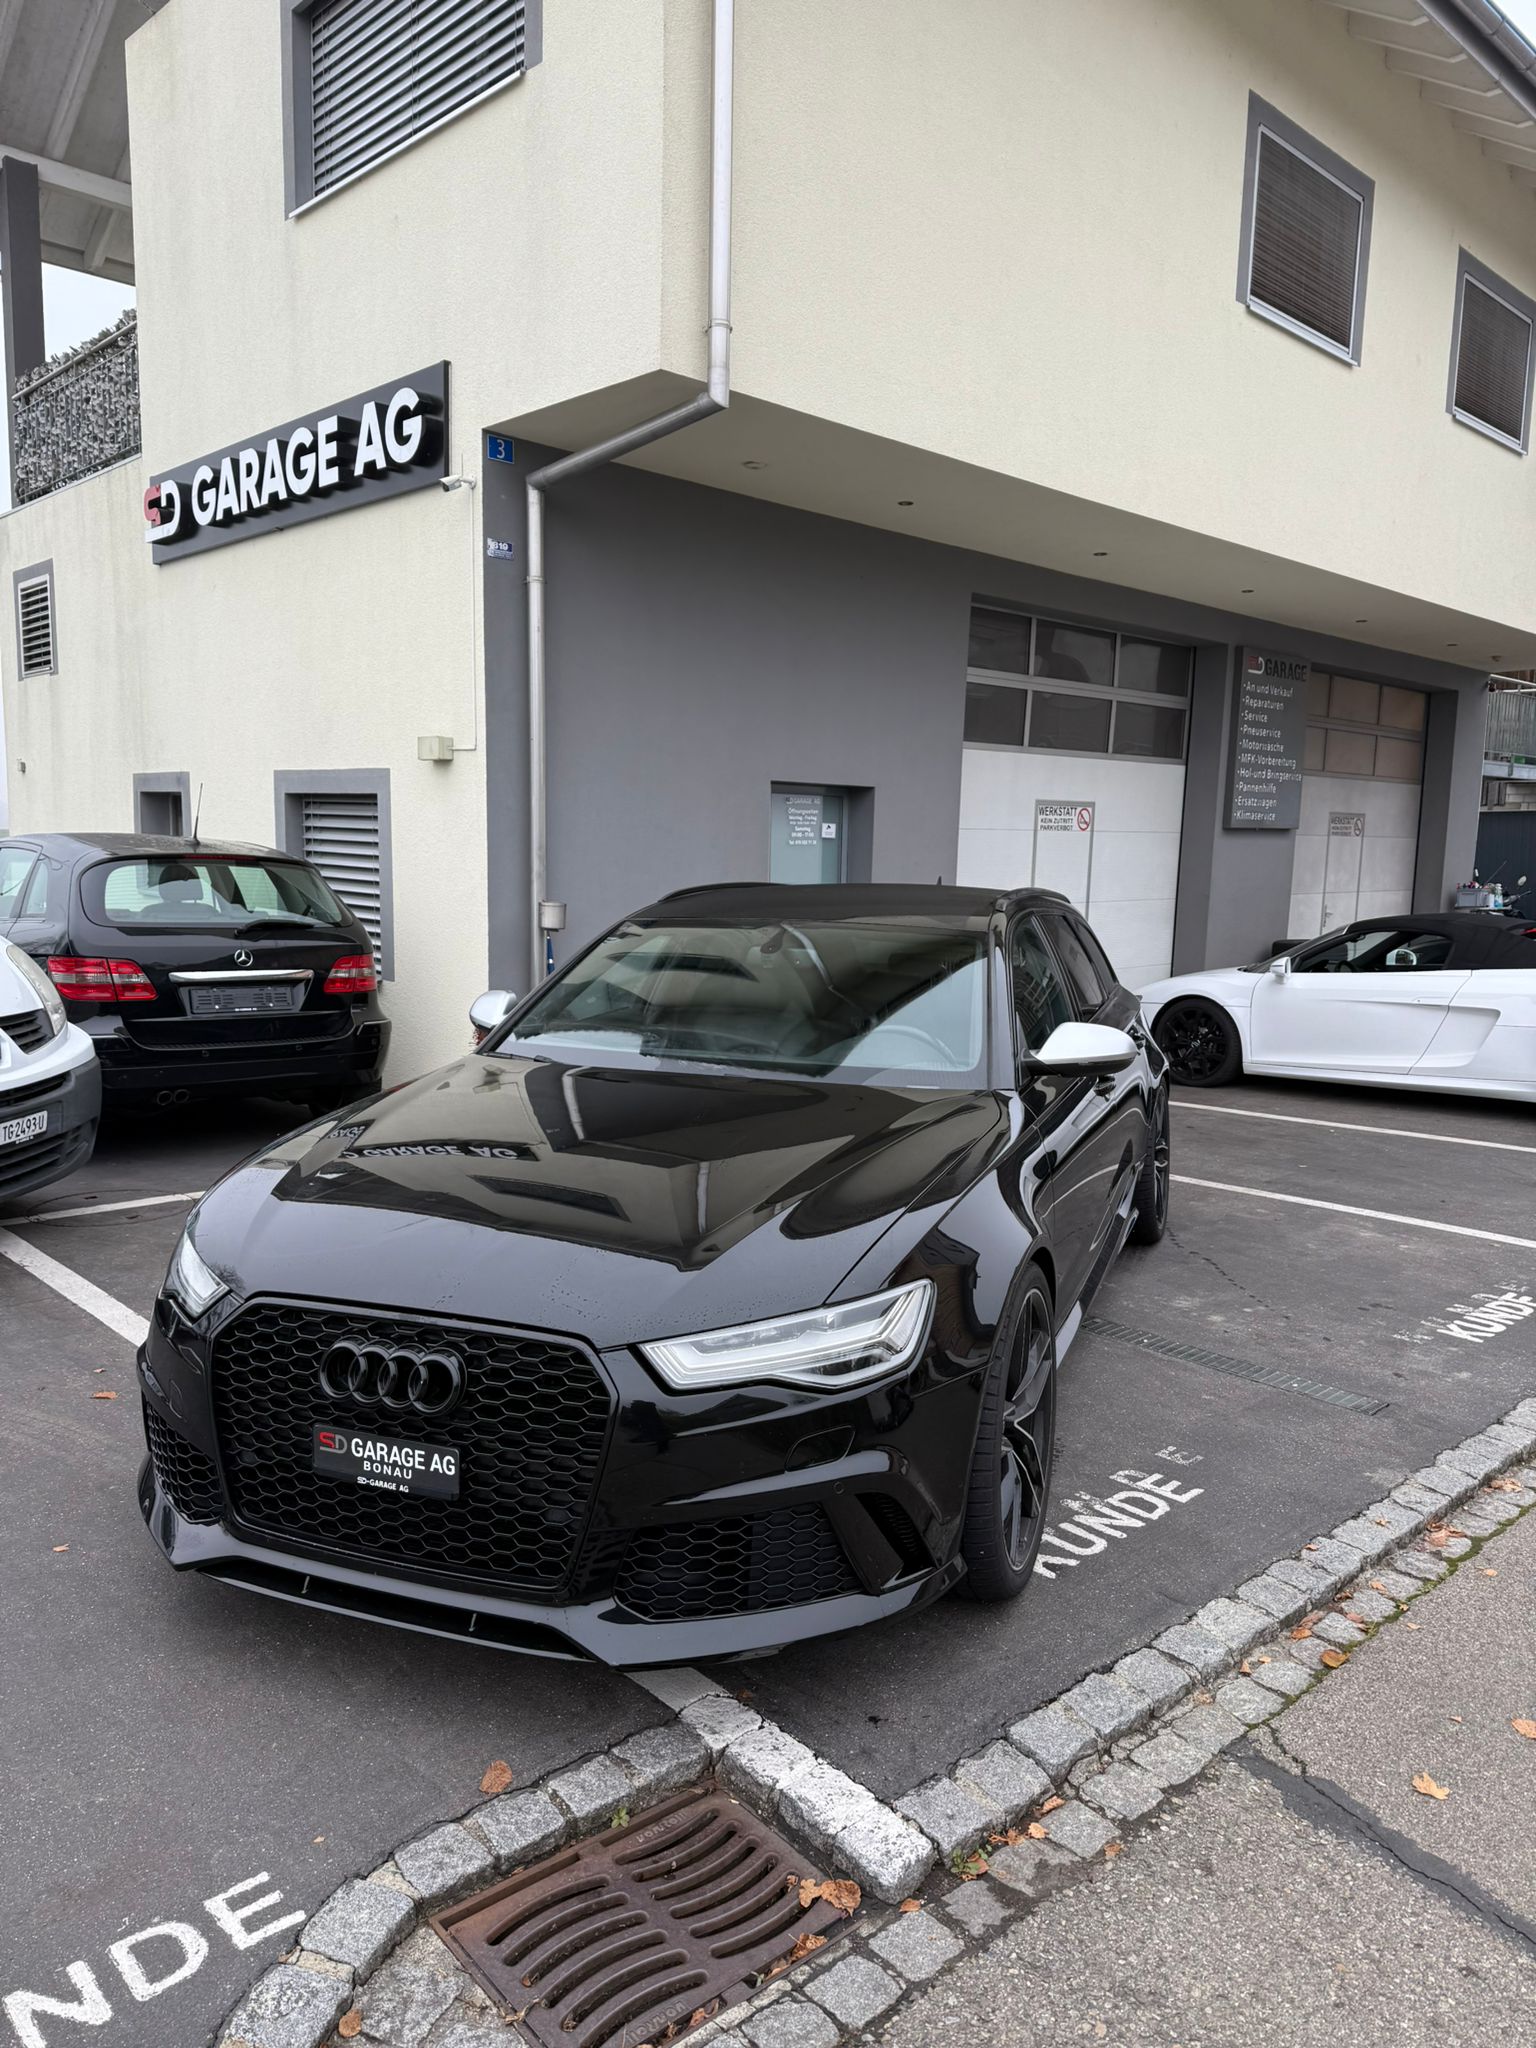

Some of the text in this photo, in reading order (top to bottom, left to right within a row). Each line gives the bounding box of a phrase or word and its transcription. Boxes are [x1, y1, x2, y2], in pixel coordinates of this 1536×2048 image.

[192, 415, 338, 526] GARAGE
[354, 387, 423, 477] AG
[496, 439, 506, 459] 3
[1265, 658, 1307, 682] GARAGE
[1245, 695, 1285, 710] Reparaturen
[1244, 710, 1268, 722] Service
[1039, 806, 1077, 817] WERKSTATT
[320, 1431, 456, 1476] SD GARAGE AG
[363, 1460, 412, 1479] BONAU
[399, 1484, 409, 1493] AG
